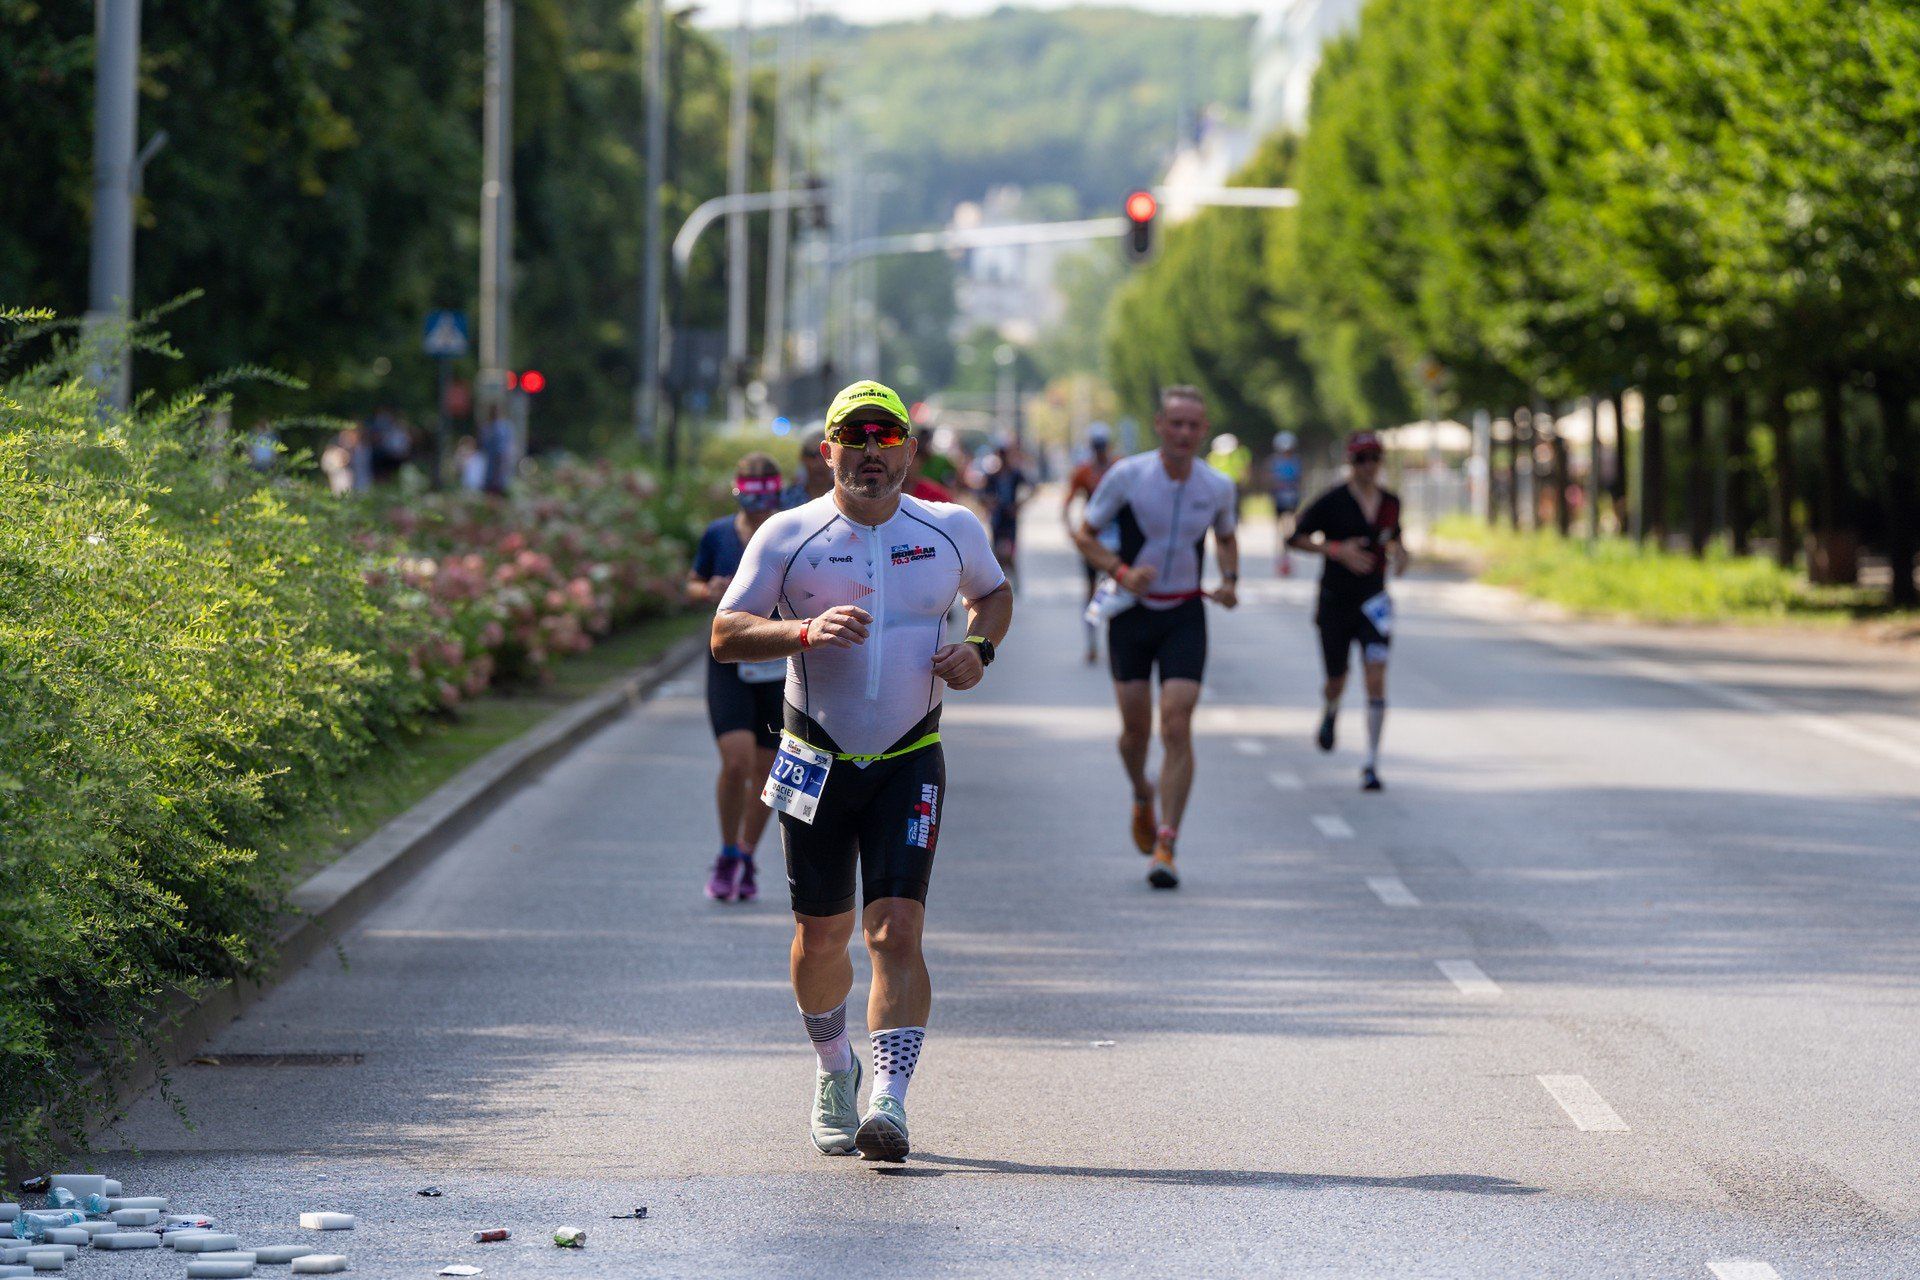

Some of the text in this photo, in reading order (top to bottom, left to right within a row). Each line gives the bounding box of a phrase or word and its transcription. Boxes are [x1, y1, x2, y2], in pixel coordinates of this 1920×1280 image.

[891, 546, 936, 560] IRONMAN
[891, 557, 910, 567] 70.3
[774, 756, 805, 785] 278
[914, 783, 933, 849] IRONMAN
[930, 785, 938, 825] GDYNIA
